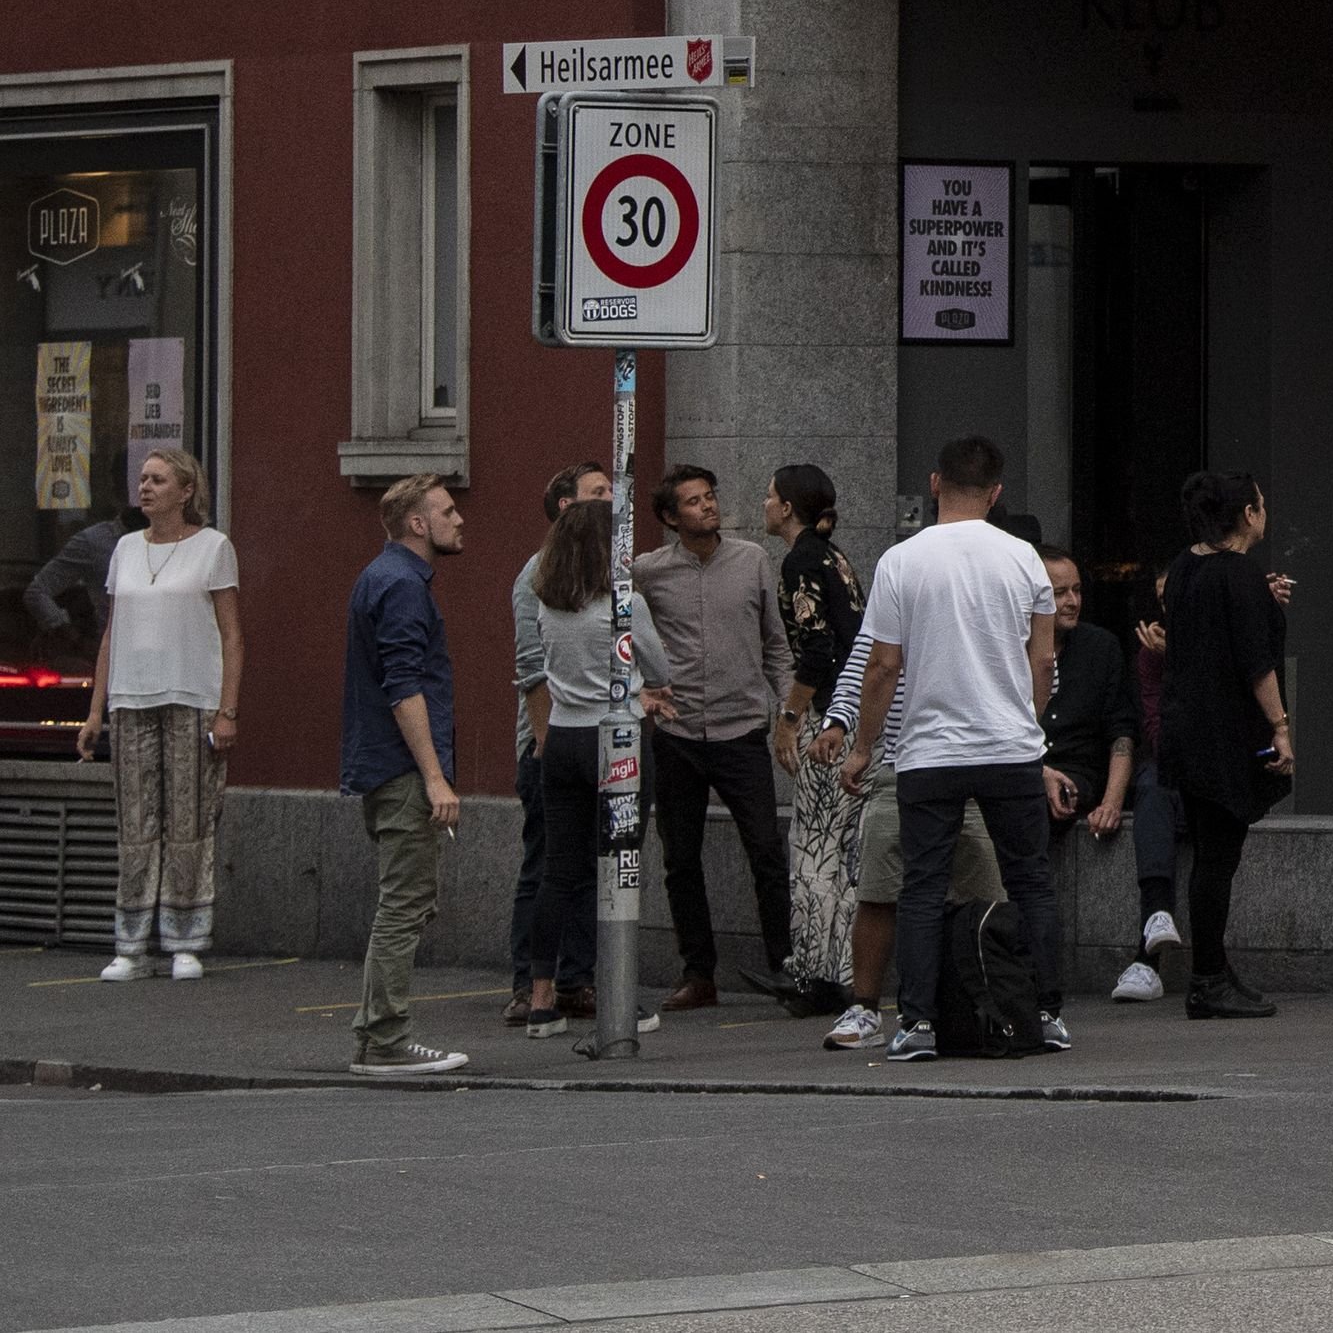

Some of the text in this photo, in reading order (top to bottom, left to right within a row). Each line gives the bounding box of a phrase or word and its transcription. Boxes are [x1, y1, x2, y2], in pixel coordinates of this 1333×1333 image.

[541, 47, 674, 84] Heilsarmee
[609, 122, 676, 149] ZONE
[942, 179, 972, 197] YOU
[932, 199, 982, 217] HAVE A
[40, 207, 88, 246] PLAZA
[615, 195, 666, 248] 30
[909, 219, 1005, 238] SUPERPOWER
[927, 239, 986, 257] AND IT'S
[931, 260, 981, 277] CALLED
[919, 279, 993, 297] KINDNESS!
[600, 298, 636, 306] RESERVOIR
[600, 304, 637, 319] DOGS
[54, 357, 70, 372] THE
[47, 376, 76, 393] SECRET
[611, 757, 635, 778] ngli
